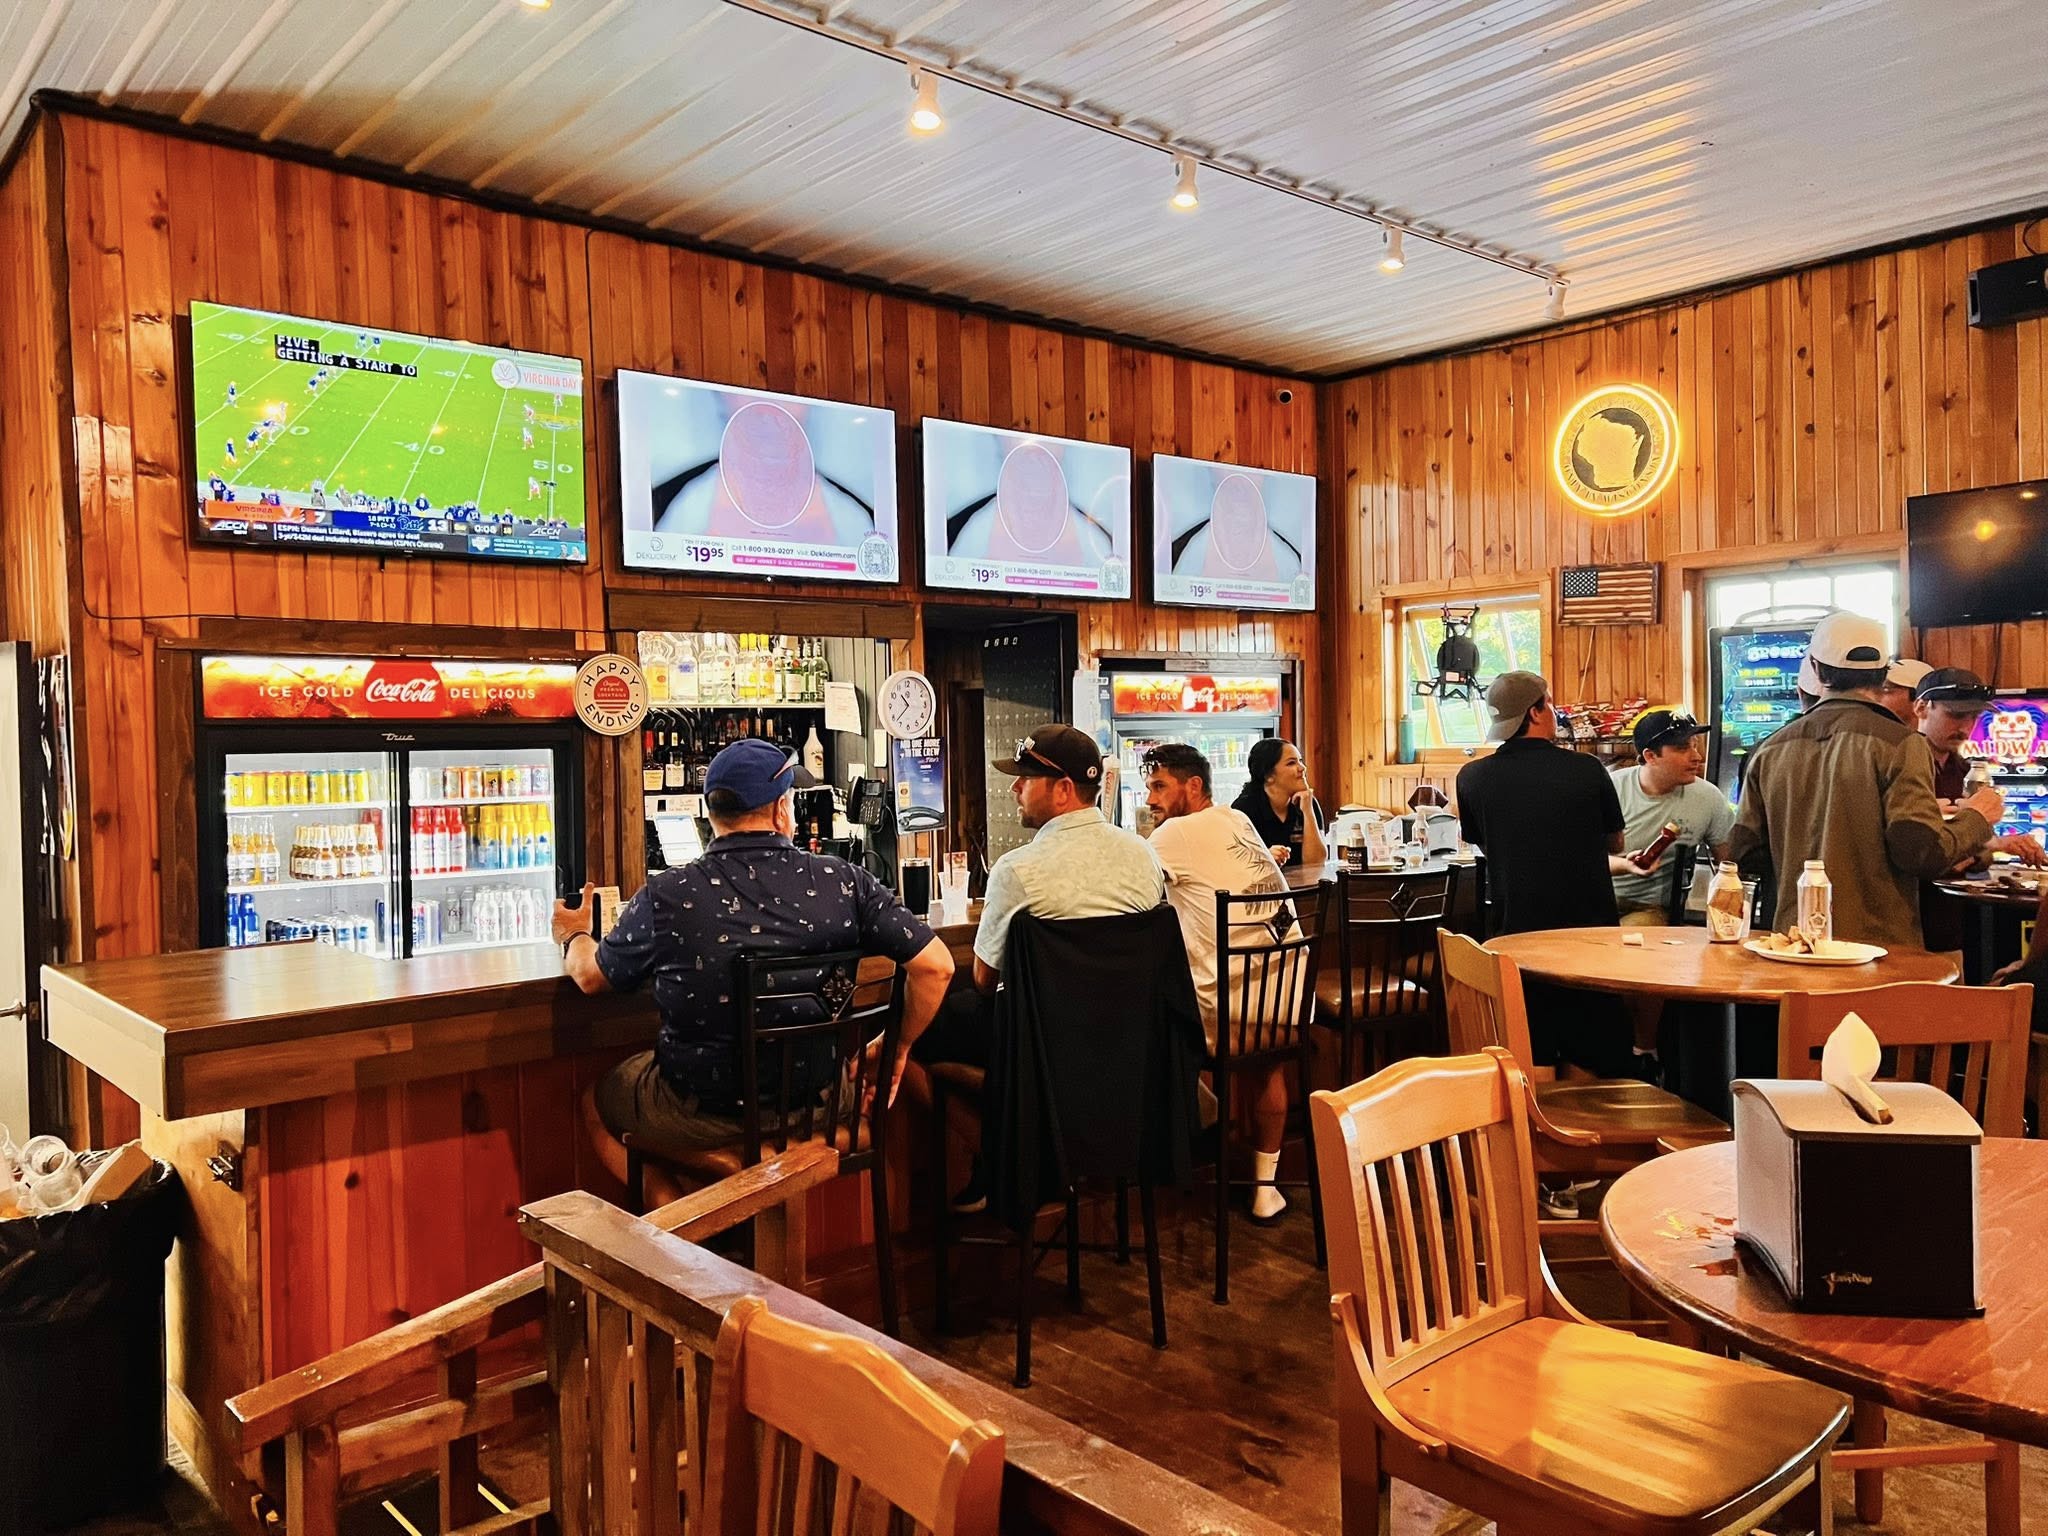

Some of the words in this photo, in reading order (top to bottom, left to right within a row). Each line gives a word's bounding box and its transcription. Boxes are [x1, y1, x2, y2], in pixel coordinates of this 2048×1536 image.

[277, 335, 316, 350] FIVE.
[276, 347, 334, 365] GETTING
[340, 356, 349, 367] A
[355, 359, 394, 373] START
[401, 365, 416, 376] TO
[523, 372, 561, 387] VIRGINIA
[563, 377, 577, 389] DAY
[211, 521, 249, 531] ACCN
[427, 520, 448, 531] 13
[528, 526, 561, 537] ACCN
[583, 662, 640, 687] HAPPY
[258, 685, 293, 698] ICE
[302, 685, 355, 698] COLD
[449, 687, 536, 699] DELICIOUS
[1136, 692, 1151, 700] ICE
[1154, 692, 1179, 700] COLD
[584, 702, 640, 727] ENDING
[924, 738, 941, 747] MORE
[912, 748, 922, 758] THE
[923, 747, 940, 757] CREW
